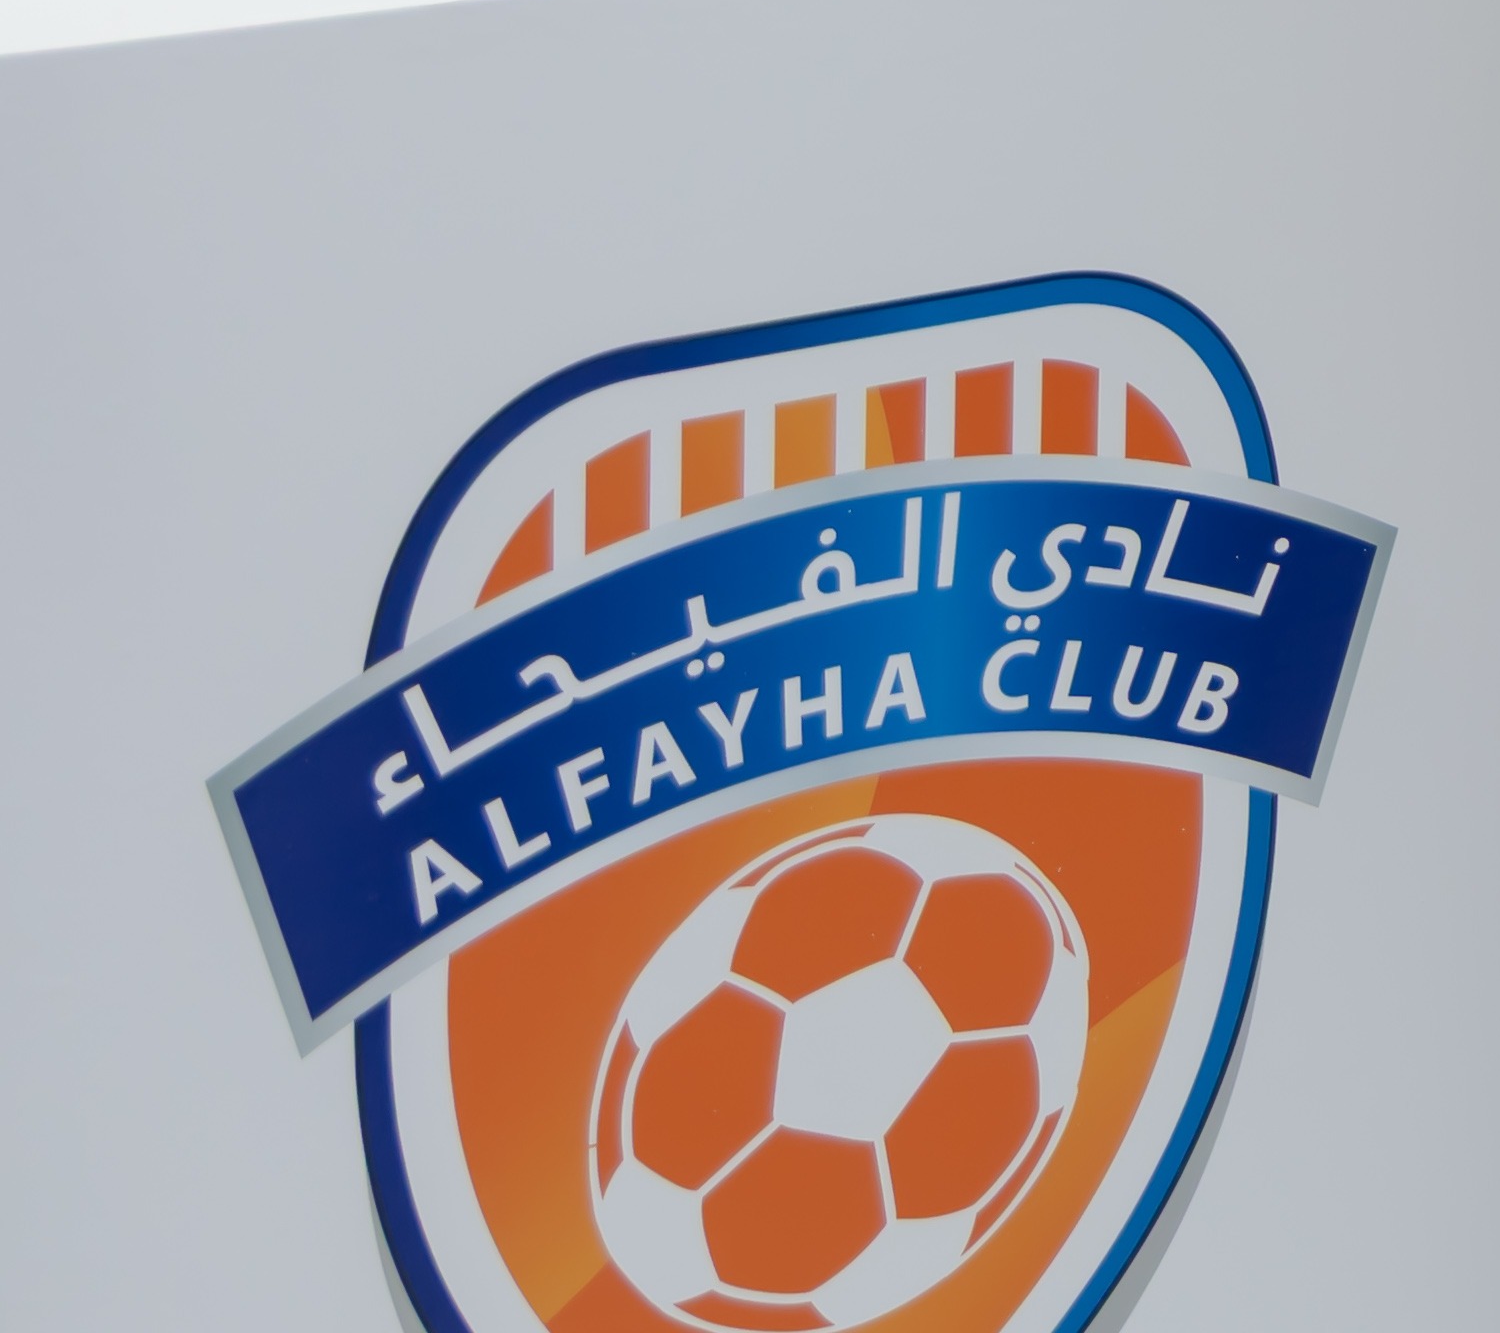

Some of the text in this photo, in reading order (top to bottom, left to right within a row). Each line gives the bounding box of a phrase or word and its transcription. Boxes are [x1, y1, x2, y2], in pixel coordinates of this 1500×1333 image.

[370, 490, 1294, 817] نادي الفيحاء
[402, 637, 1241, 927] ALFAYHA CLUB
